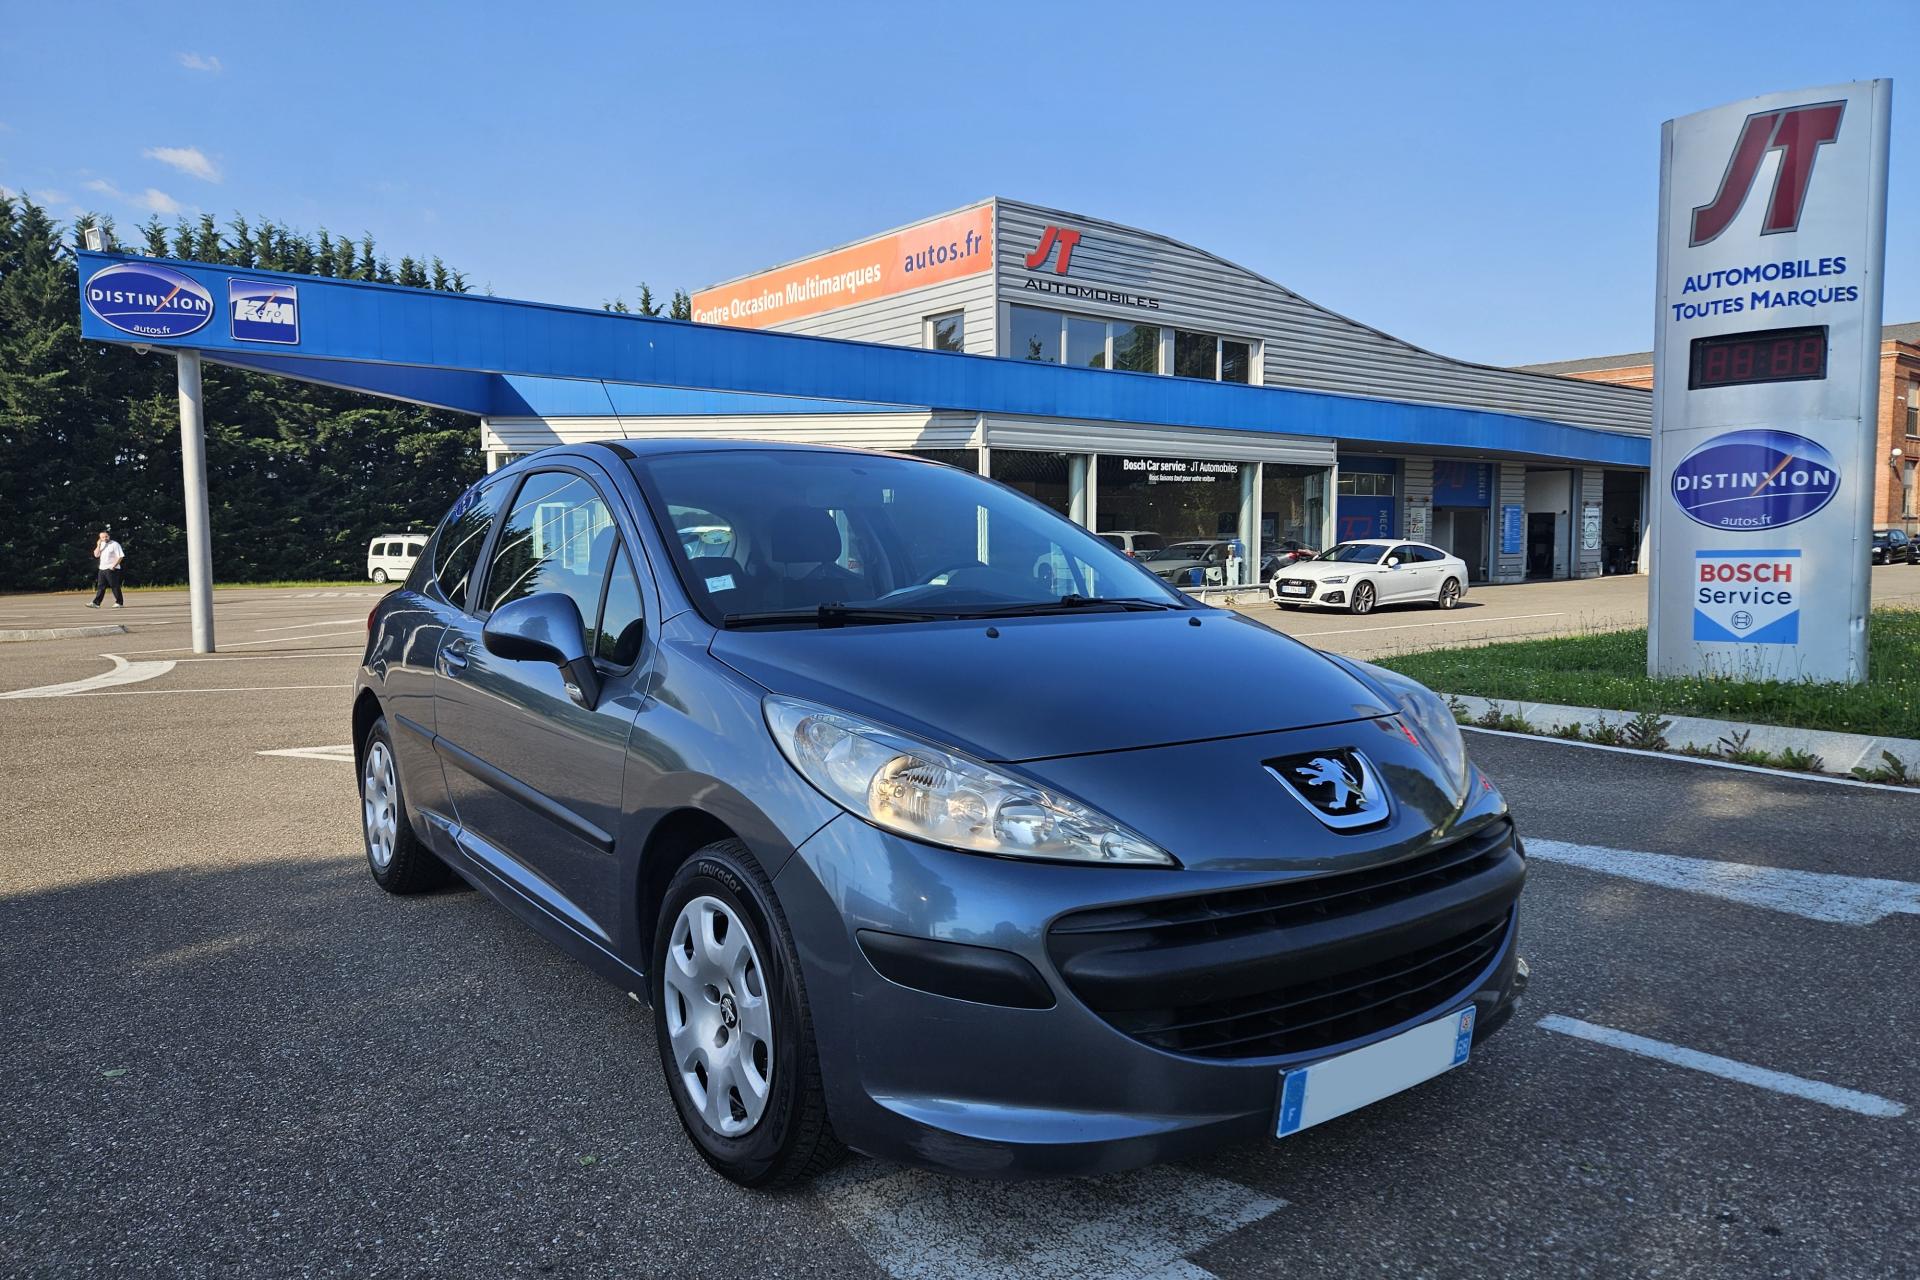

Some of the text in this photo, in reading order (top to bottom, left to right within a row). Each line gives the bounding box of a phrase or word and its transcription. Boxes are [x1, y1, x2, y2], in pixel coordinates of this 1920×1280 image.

[1689, 99, 1848, 248] JT
[905, 231, 982, 273] autos.fr
[1024, 225, 1082, 276] JT
[1682, 256, 1847, 294] AUTOMOBILES
[91, 288, 207, 312] DISTINXION
[694, 264, 881, 324] Centre Occasion Multimarques
[1024, 279, 1160, 310] AUTOMOBILES
[133, 324, 171, 335] autos.fr
[1123, 459, 1146, 470] Bosch
[1147, 460, 1160, 471] Car
[1160, 461, 1186, 471] service
[1191, 461, 1199, 472] JT
[1200, 462, 1238, 473] Automobiles
[1677, 469, 1830, 492] DISTINXION
[1720, 514, 1772, 526] autos.fr
[1699, 563, 1793, 583] BOSCH
[1698, 586, 1793, 605] Service
[698, 861, 741, 895] Tourador
[1287, 1107, 1297, 1122] F
